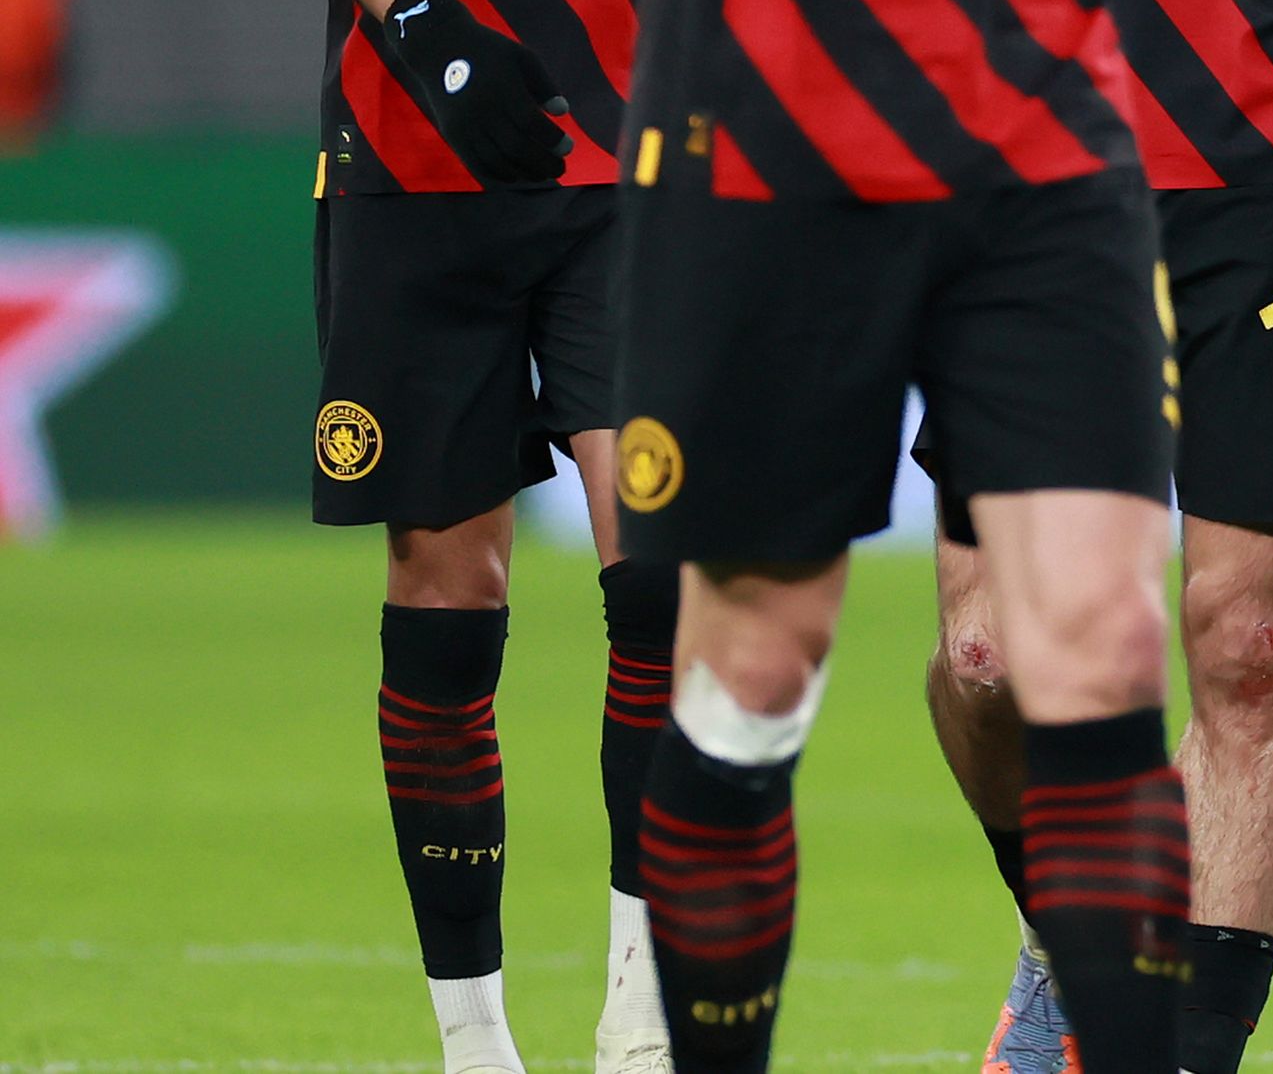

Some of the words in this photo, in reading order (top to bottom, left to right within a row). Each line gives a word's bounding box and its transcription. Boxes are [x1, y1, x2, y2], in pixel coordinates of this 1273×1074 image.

[320, 407, 372, 430] MANCHESTER
[335, 466, 357, 474] CITY
[421, 843, 502, 865] CITY
